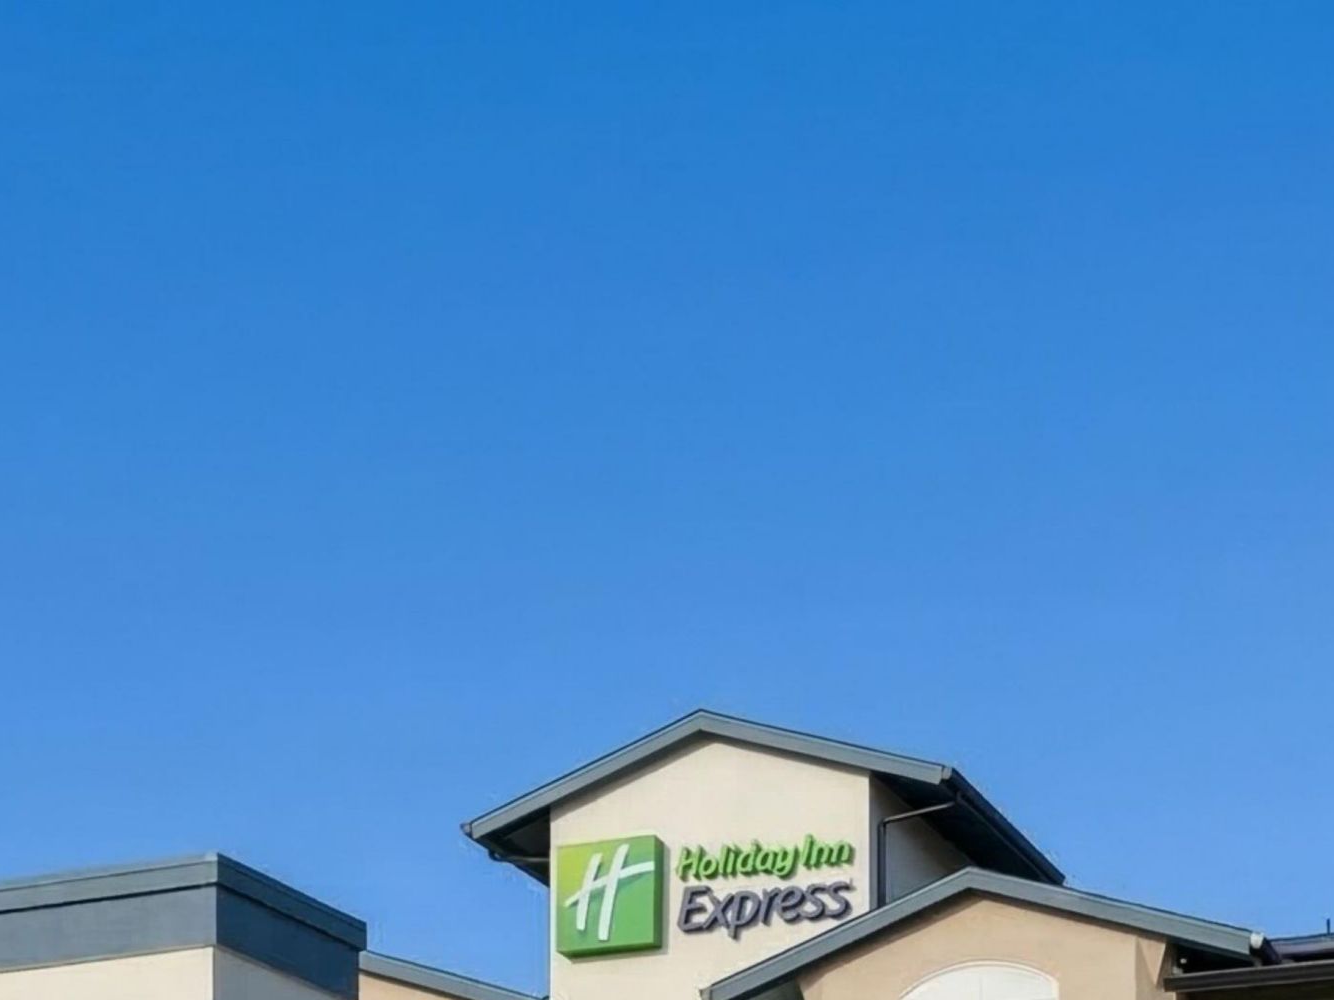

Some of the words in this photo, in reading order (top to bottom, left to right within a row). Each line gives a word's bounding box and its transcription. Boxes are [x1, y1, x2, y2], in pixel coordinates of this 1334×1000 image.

[676, 839, 795, 879] Holiday
[801, 833, 853, 869] Inn
[564, 843, 655, 941] H
[678, 881, 853, 939] Express
